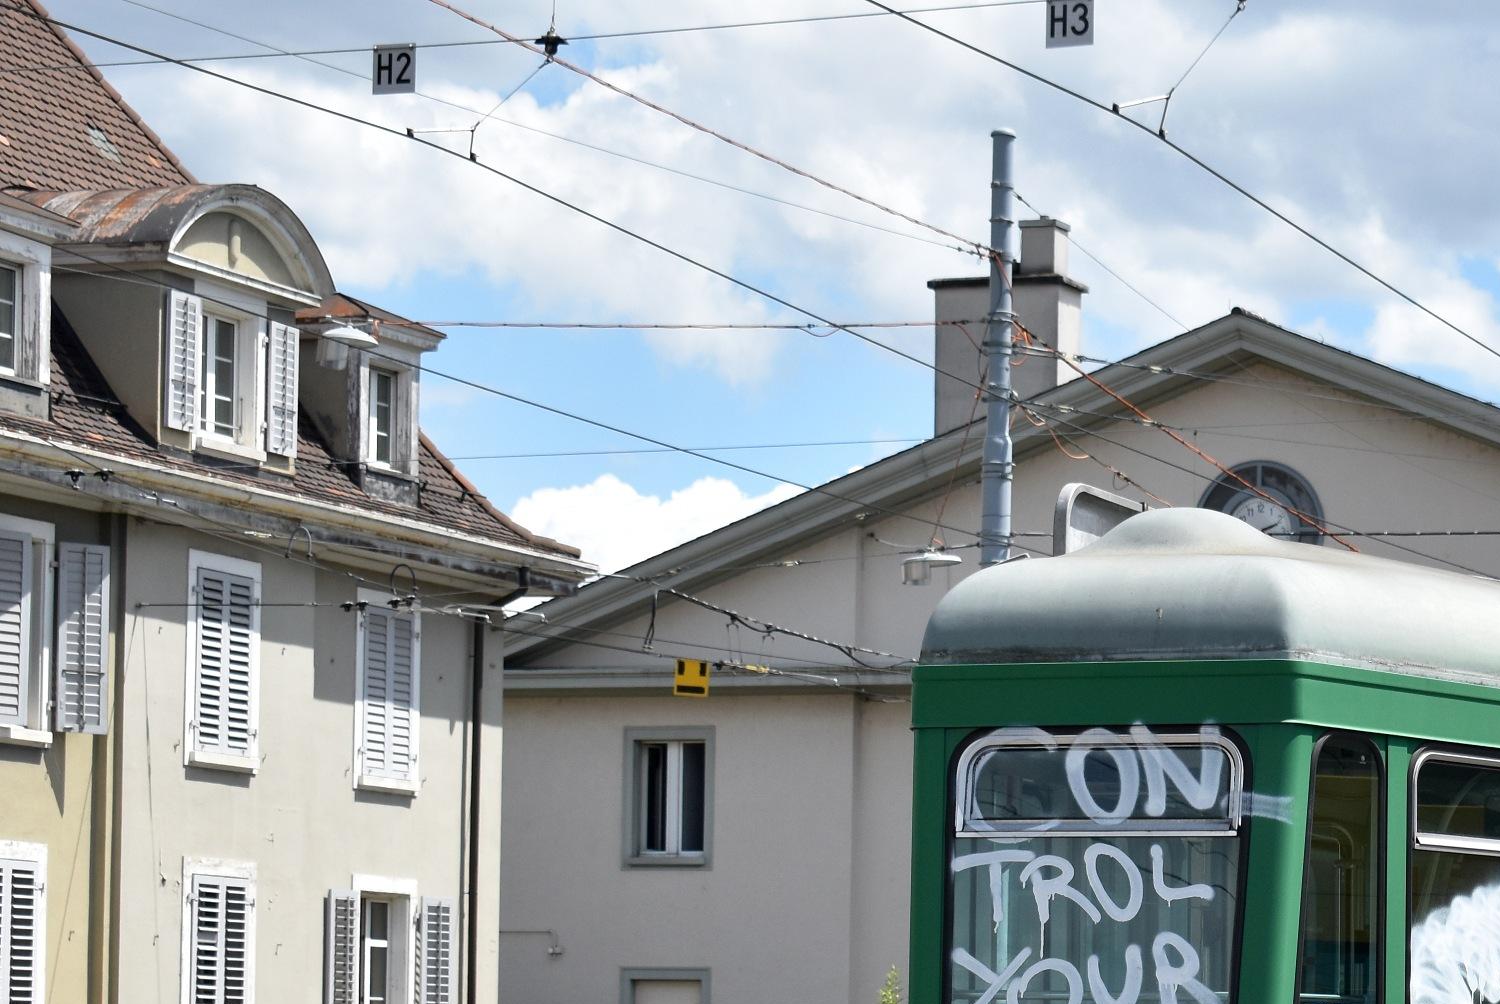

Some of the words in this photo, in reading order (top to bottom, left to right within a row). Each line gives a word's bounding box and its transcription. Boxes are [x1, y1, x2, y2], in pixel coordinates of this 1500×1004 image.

[1050, 3, 1089, 38] H3
[377, 52, 411, 85] H2
[951, 842, 1216, 935] TROL
